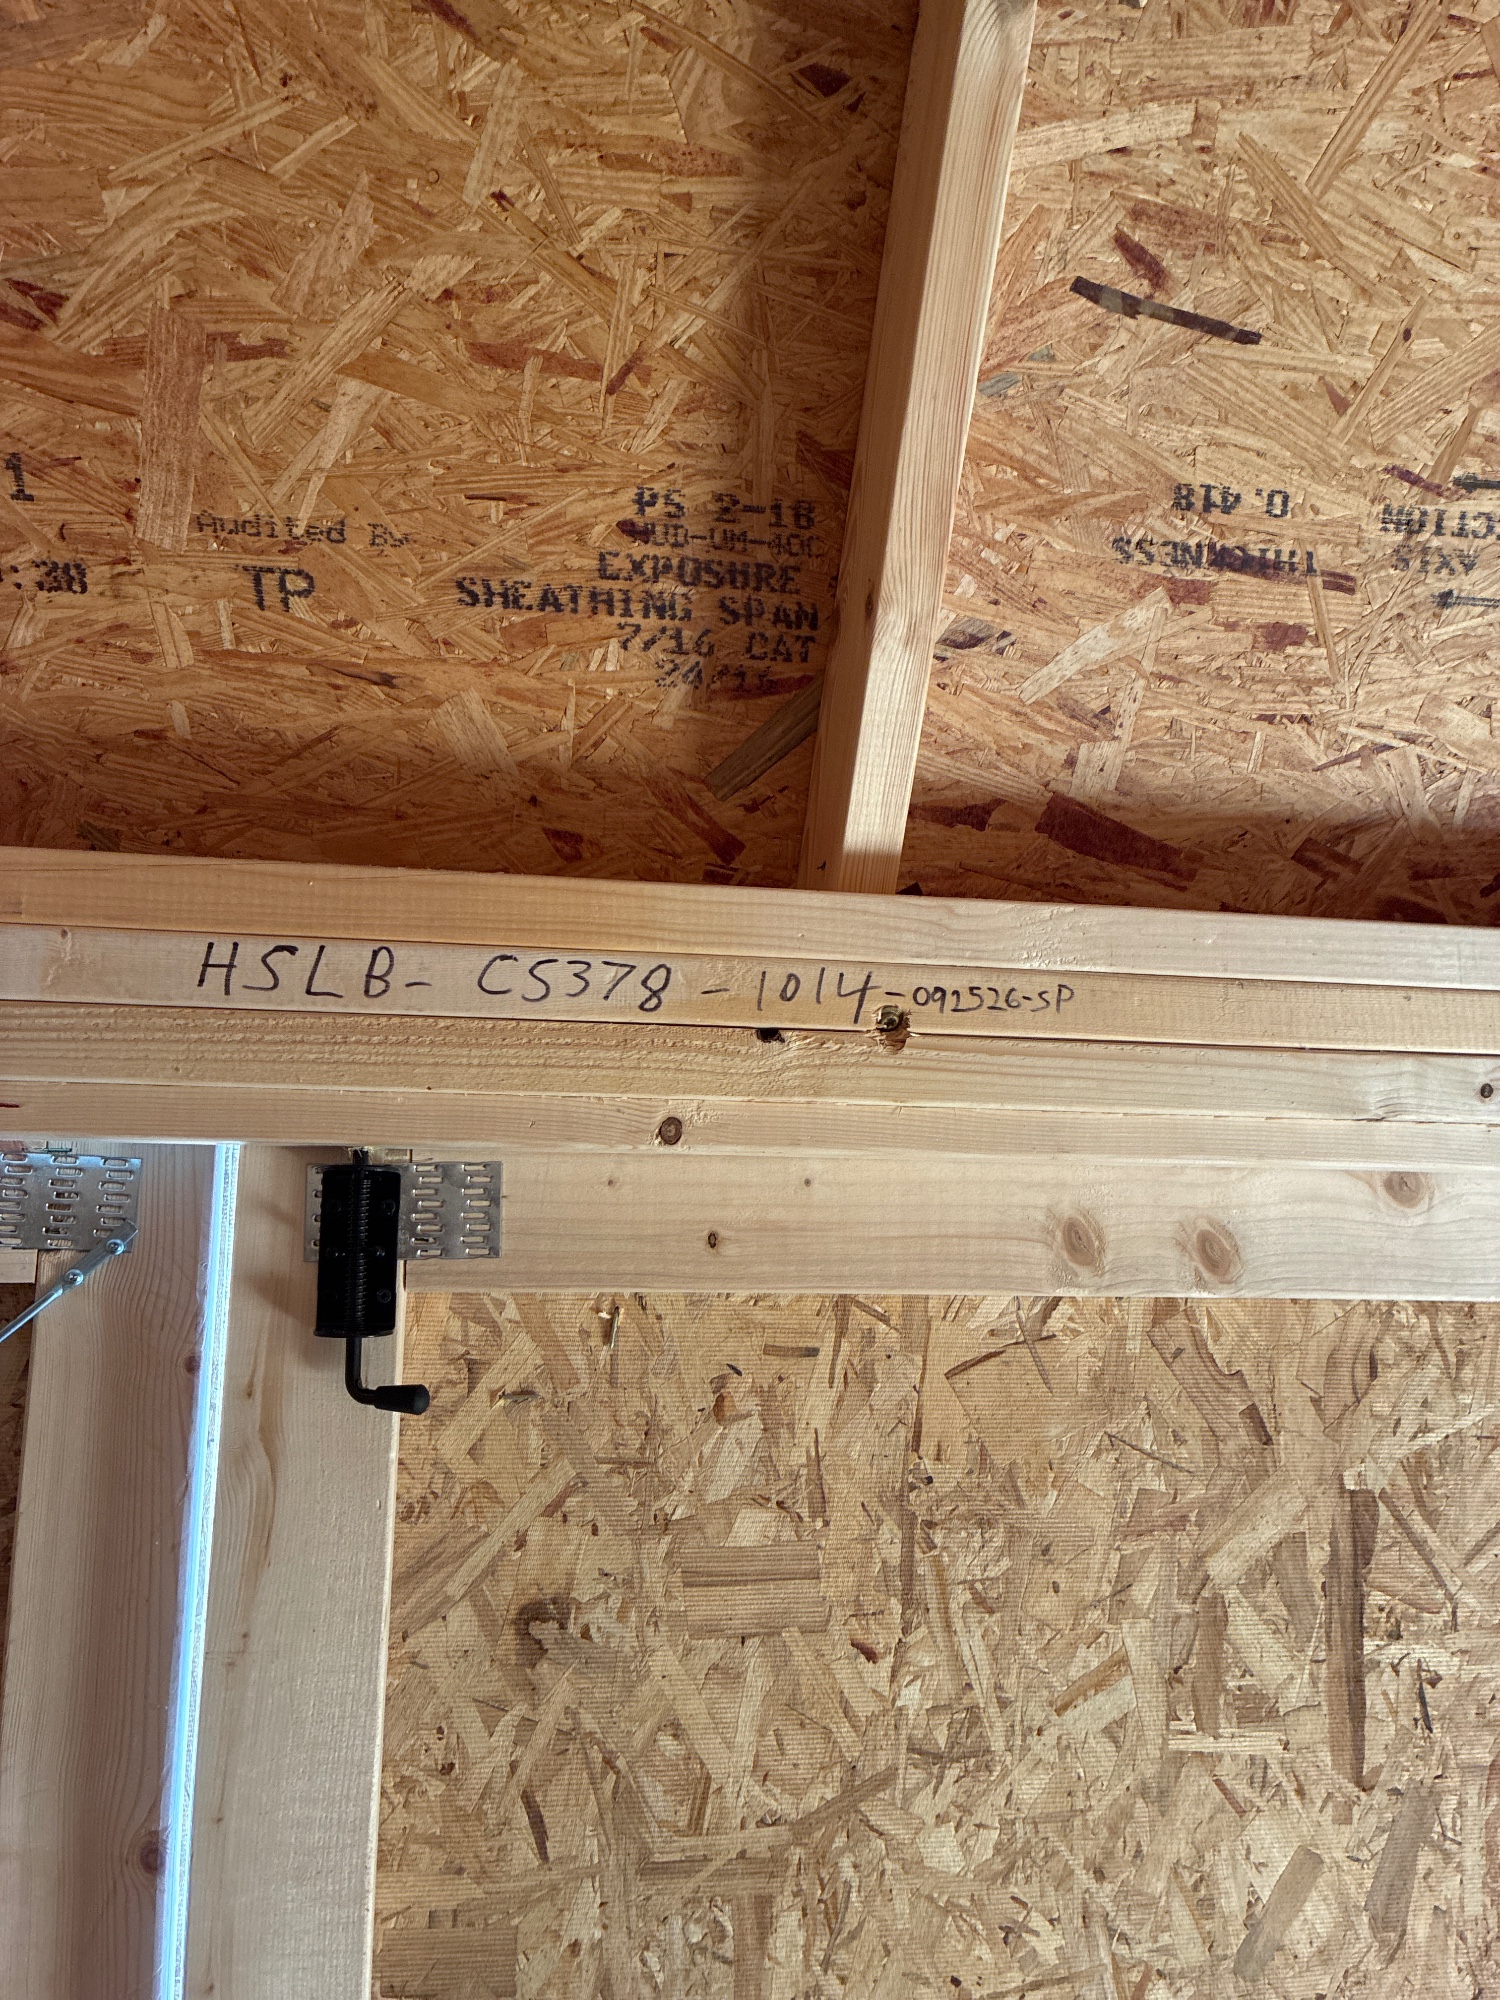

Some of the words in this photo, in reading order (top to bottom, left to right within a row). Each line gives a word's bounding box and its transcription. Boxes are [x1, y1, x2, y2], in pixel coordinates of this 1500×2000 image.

[630, 485, 686, 520] PS
[1172, 482, 1291, 519] 0.418
[1380, 503, 1500, 542] CTION
[238, 563, 316, 613] TP
[597, 550, 801, 595] EXPOSURE
[456, 576, 694, 622] SHEATHING
[719, 594, 820, 631] SPAN
[616, 621, 715, 658] 7/16
[744, 631, 817, 664] CAT
